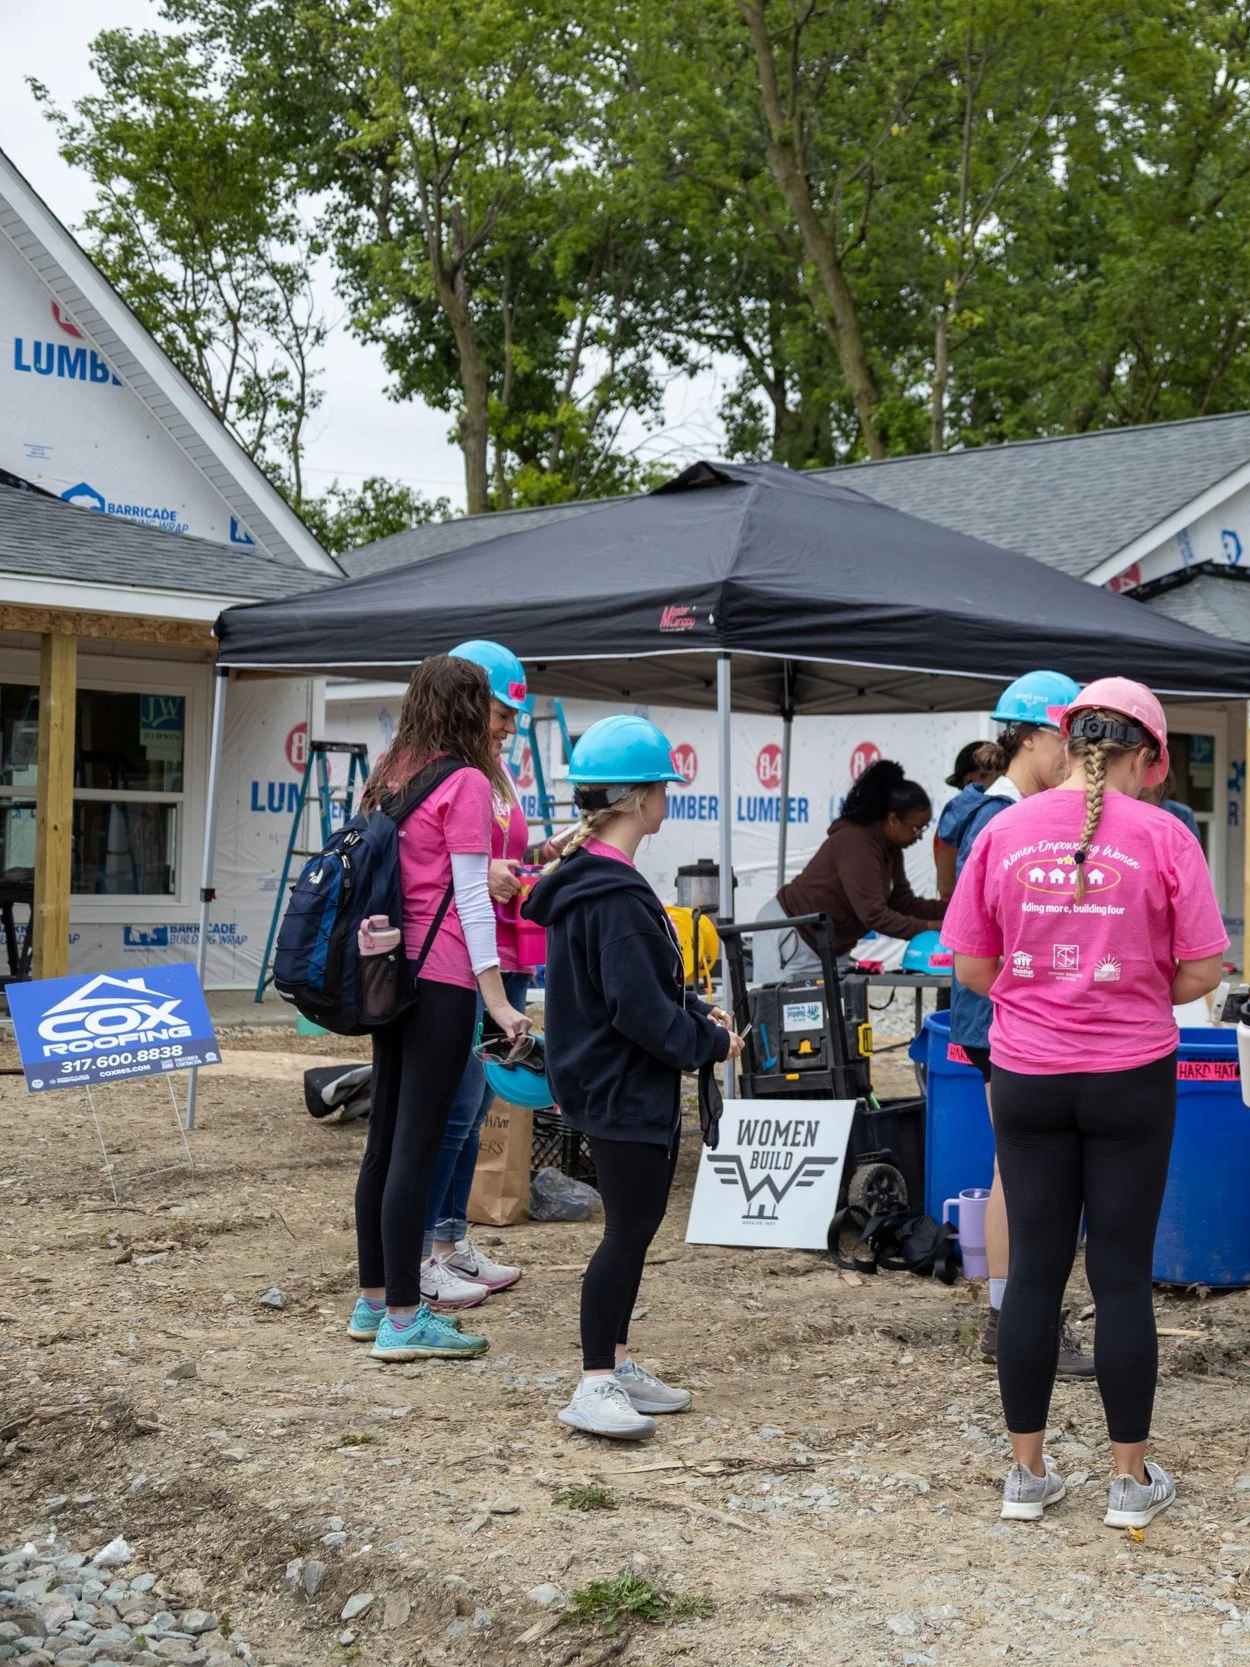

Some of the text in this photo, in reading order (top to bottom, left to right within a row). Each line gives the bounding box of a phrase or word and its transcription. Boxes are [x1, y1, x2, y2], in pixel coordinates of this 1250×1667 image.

[14, 337, 123, 386] LUMB
[108, 503, 177, 522] BARRICADE
[758, 751, 783, 781] 84
[1003, 840, 1140, 870] Women Empoweng Women
[1045, 904, 1072, 914] more,
[1073, 903, 1108, 915] building
[1108, 904, 1125, 915] four
[170, 923, 236, 934] BARRCADE
[219, 934, 247, 946] WRAP
[37, 999, 189, 1042] COX
[42, 1025, 192, 1057] ROOFING
[61, 1045, 183, 1073] 317.600.8838
[99, 1064, 151, 1077] COXRES.COM
[1179, 1063, 1211, 1079] HARD
[737, 1119, 820, 1147] WOMEN
[750, 1150, 793, 1170] BUILD
